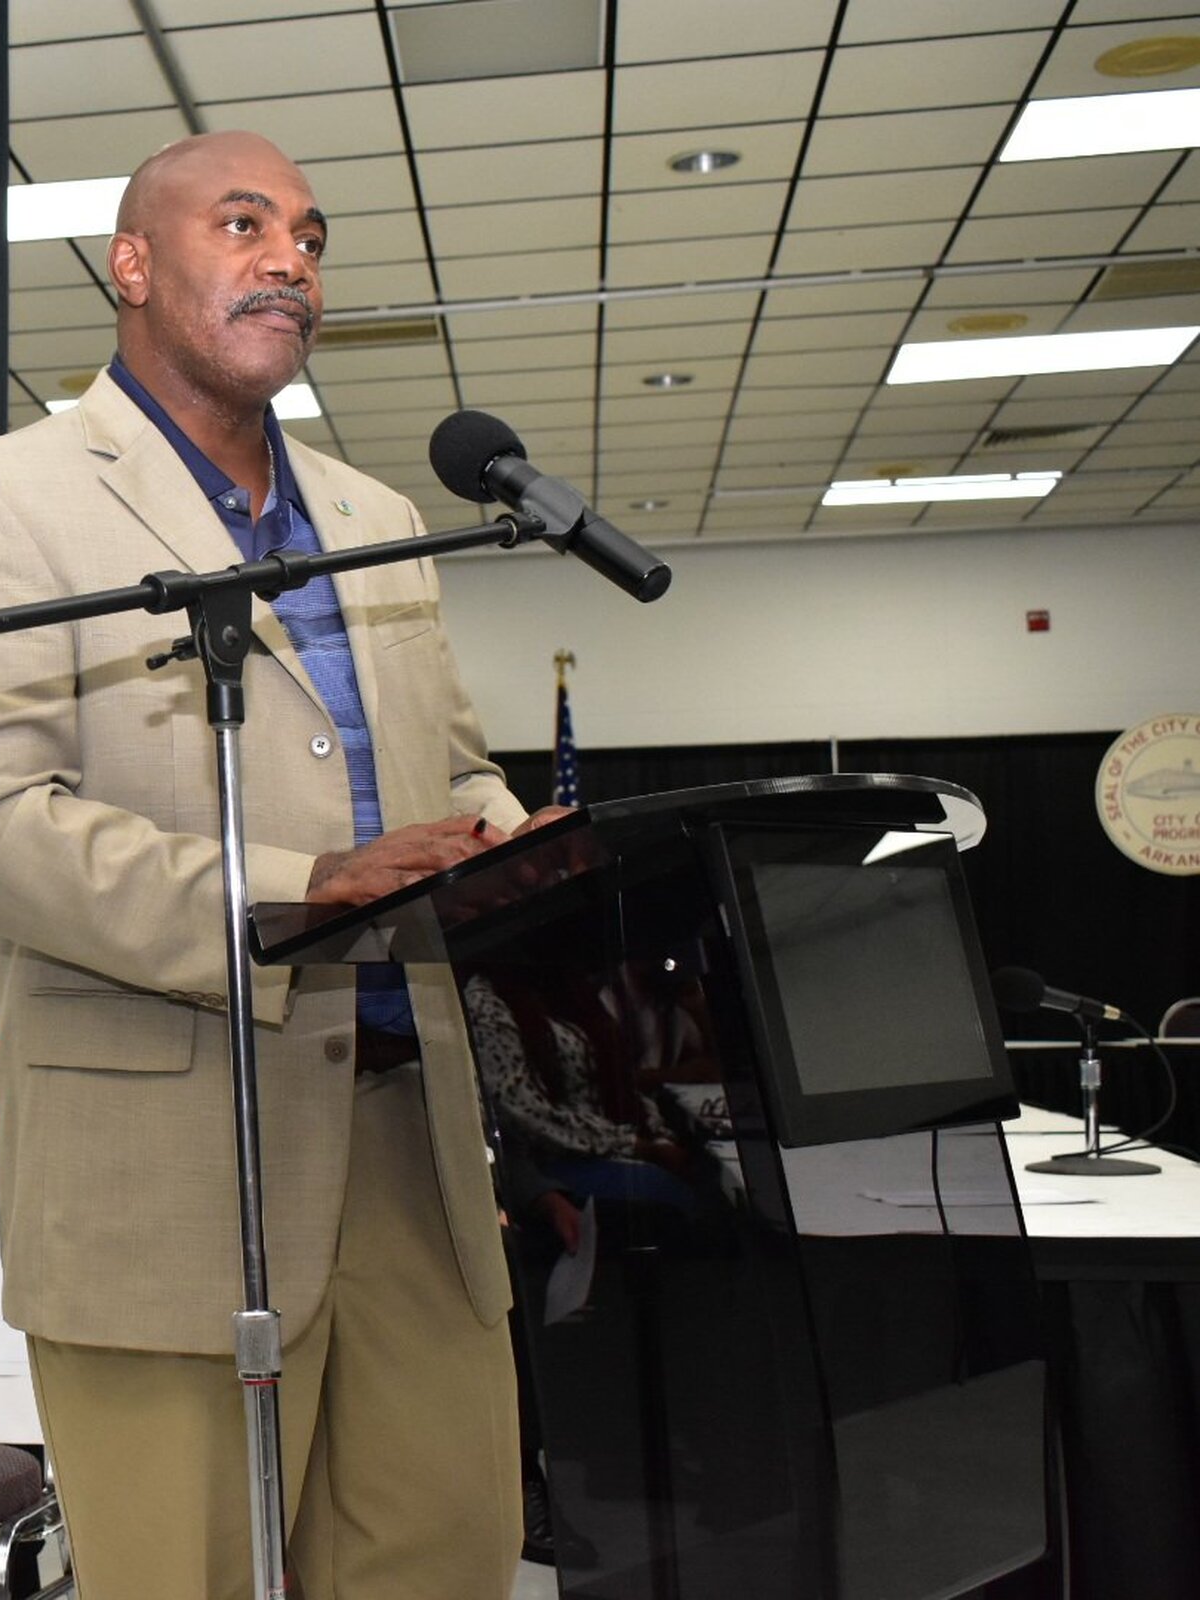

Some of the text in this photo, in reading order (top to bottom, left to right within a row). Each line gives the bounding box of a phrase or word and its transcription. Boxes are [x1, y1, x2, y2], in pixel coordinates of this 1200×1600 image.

[1105, 719, 1189, 821] SEAL OF THE CITY
[1153, 815, 1187, 827] CITY
